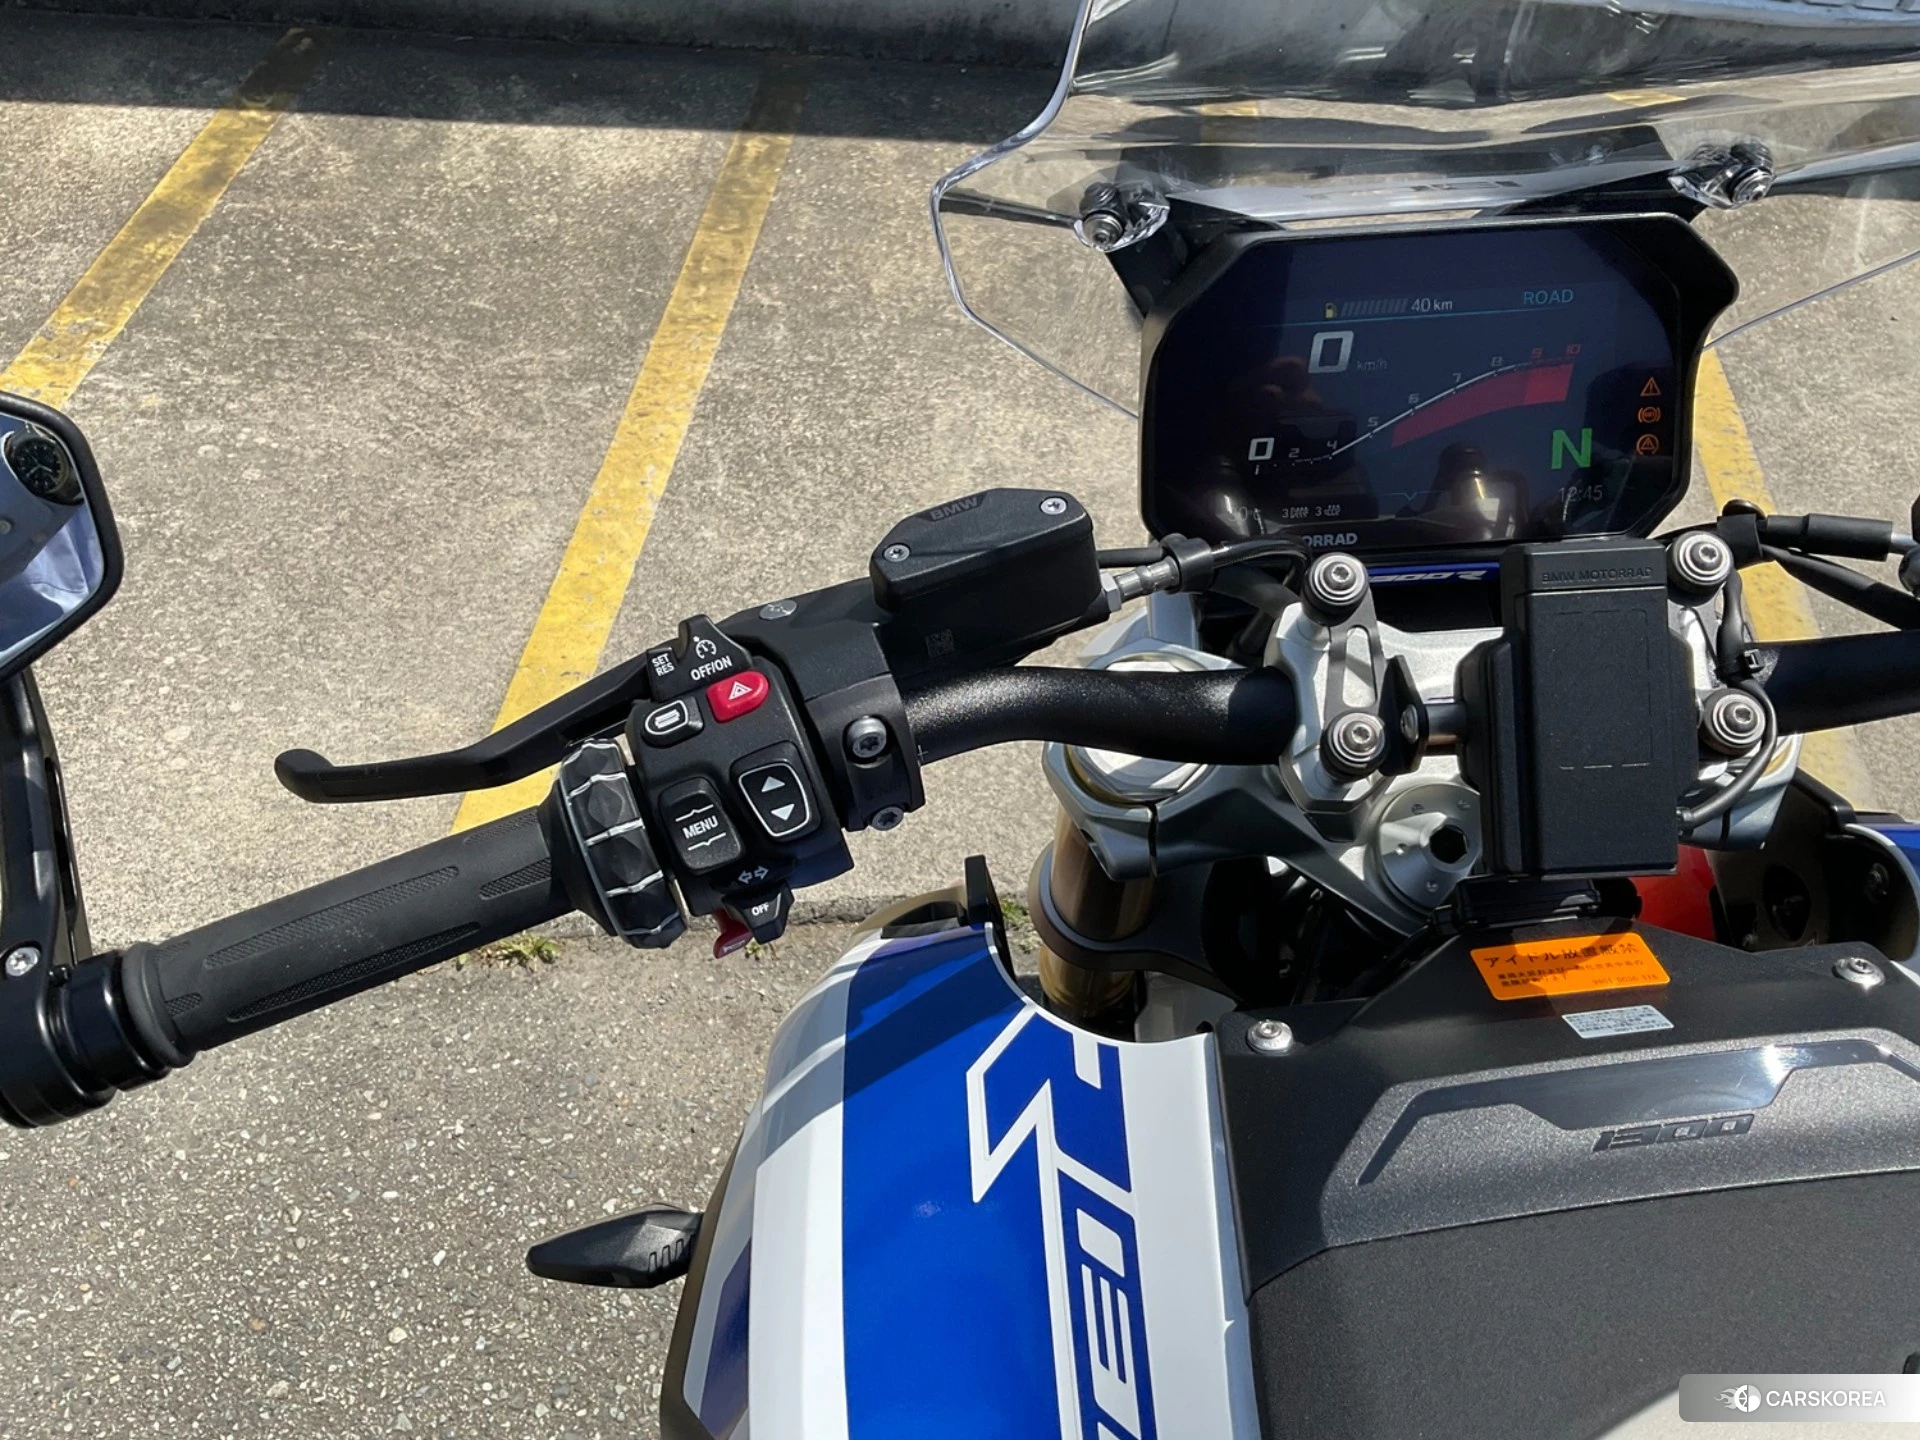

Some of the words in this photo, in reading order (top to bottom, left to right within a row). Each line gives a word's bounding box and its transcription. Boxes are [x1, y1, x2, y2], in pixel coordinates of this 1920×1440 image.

[1523, 288, 1574, 305] ROAD
[1411, 298, 1431, 313] 40
[1433, 297, 1453, 312] km
[1308, 330, 1354, 374] 0
[1530, 347, 1543, 359] 9
[1564, 344, 1582, 355] 10
[1356, 357, 1388, 372] km/h
[1490, 357, 1504, 367] 8
[1452, 373, 1463, 383] 7
[1408, 393, 1420, 404] 6
[1367, 417, 1379, 427] 5
[1248, 437, 1275, 461] 0
[1287, 448, 1300, 458] 2
[1325, 440, 1338, 451] 4
[1551, 428, 1593, 470] N
[929, 497, 979, 521] BMW
[1302, 533, 1358, 548] ORRAD
[1542, 570, 1576, 584] BMW
[1578, 567, 1654, 581] MOTORRAD
[652, 653, 670, 669] SET
[655, 661, 675, 677] RES
[690, 655, 733, 681] OFF/ON
[682, 815, 719, 839] MENU
[751, 901, 771, 917] OFF
[1593, 1112, 1755, 1152] 1300
